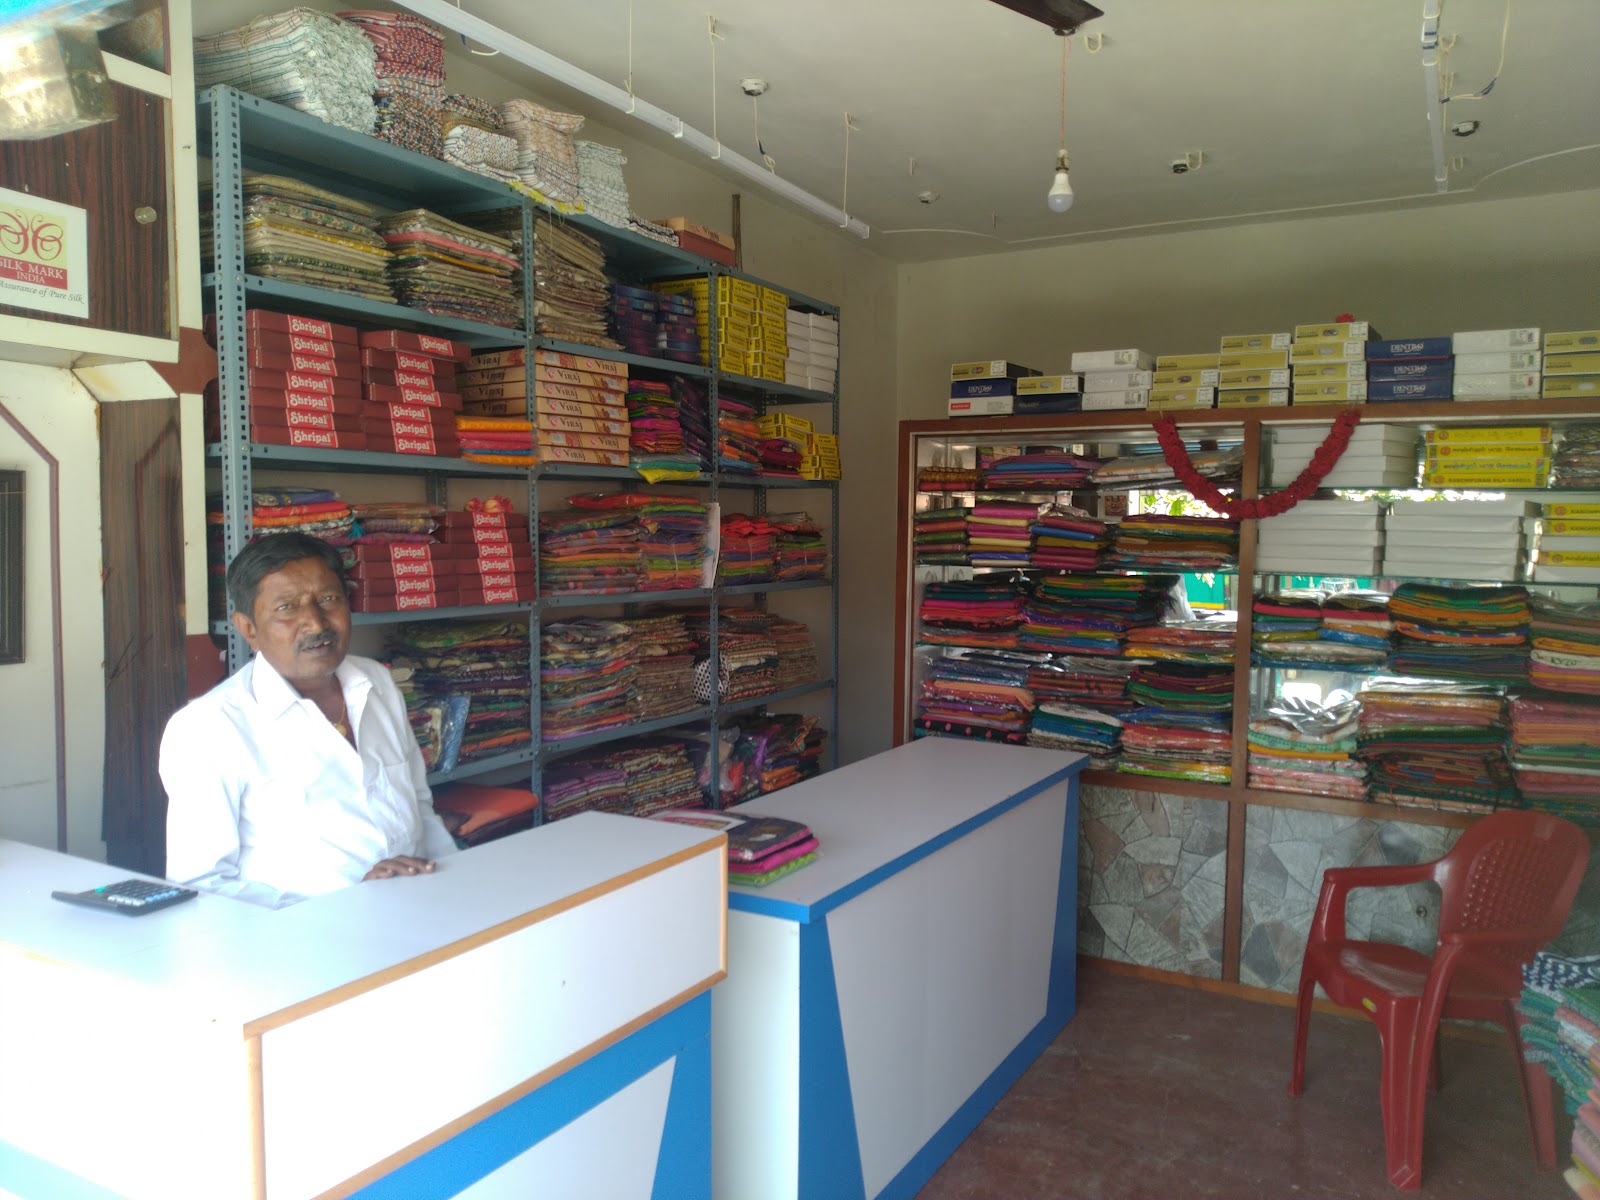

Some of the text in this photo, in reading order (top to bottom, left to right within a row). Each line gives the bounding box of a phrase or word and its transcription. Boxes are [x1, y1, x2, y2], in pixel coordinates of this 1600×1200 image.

[17, 272, 45, 283] INDIA
[29, 264, 64, 279] MARK
[0, 281, 37, 293] Assurance
[39, 288, 49, 297] of
[49, 290, 66, 299] Pure
[292, 319, 326, 338] Shripal
[294, 337, 328, 356] Shripal
[422, 338, 448, 353] Shripal
[296, 356, 331, 374] Shripal
[400, 356, 428, 372] Shripal
[291, 376, 327, 393] Shripal
[399, 374, 427, 389] Shripal
[290, 394, 327, 411] Shripal
[405, 389, 434, 405] Shripal
[393, 406, 425, 420] Shripal
[291, 412, 327, 429] Shripal
[396, 423, 427, 437] Shripal
[294, 431, 331, 446] Shripal
[398, 439, 430, 452] Shripal
[476, 515, 501, 525] Shripal
[477, 530, 503, 541] Shripal
[394, 546, 425, 558] Shripal
[481, 545, 507, 557] Shripal
[396, 562, 428, 575] Shripal
[481, 560, 510, 571] Shripal
[400, 579, 430, 592] Shripal
[485, 575, 510, 586] Shripal
[400, 595, 431, 608] Shripal
[487, 590, 513, 600] Shripal
